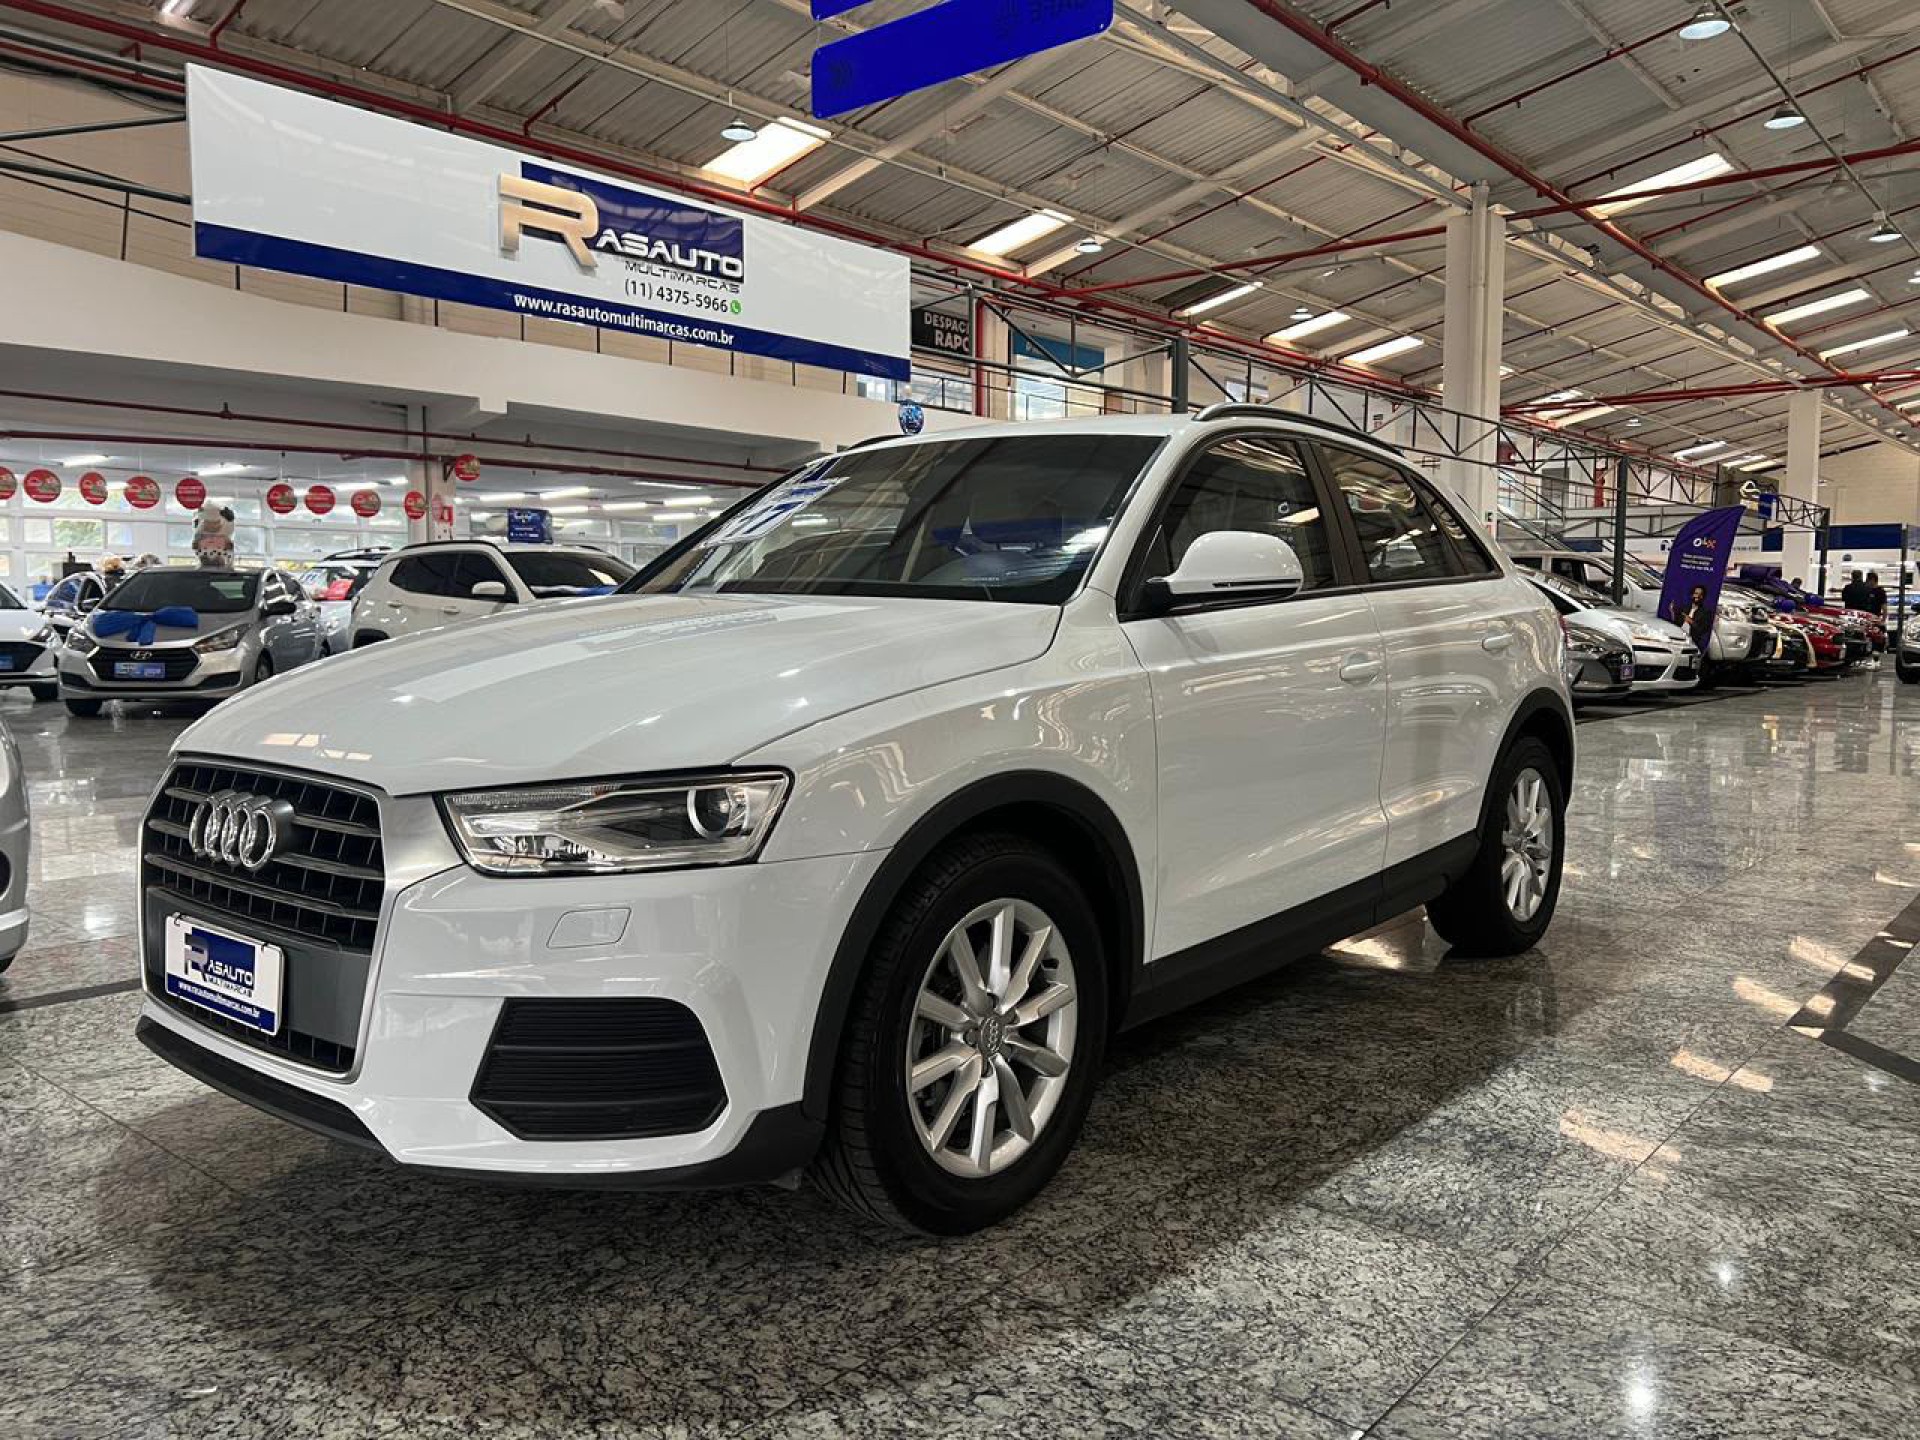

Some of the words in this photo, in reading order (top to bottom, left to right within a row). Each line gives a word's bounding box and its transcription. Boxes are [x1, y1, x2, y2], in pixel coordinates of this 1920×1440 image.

[499, 172, 743, 277] RASAUTO
[513, 293, 735, 346] www.rasautomultimarcas.com.br
[624, 278, 653, 301] (11)
[656, 286, 729, 313] 4375-5966
